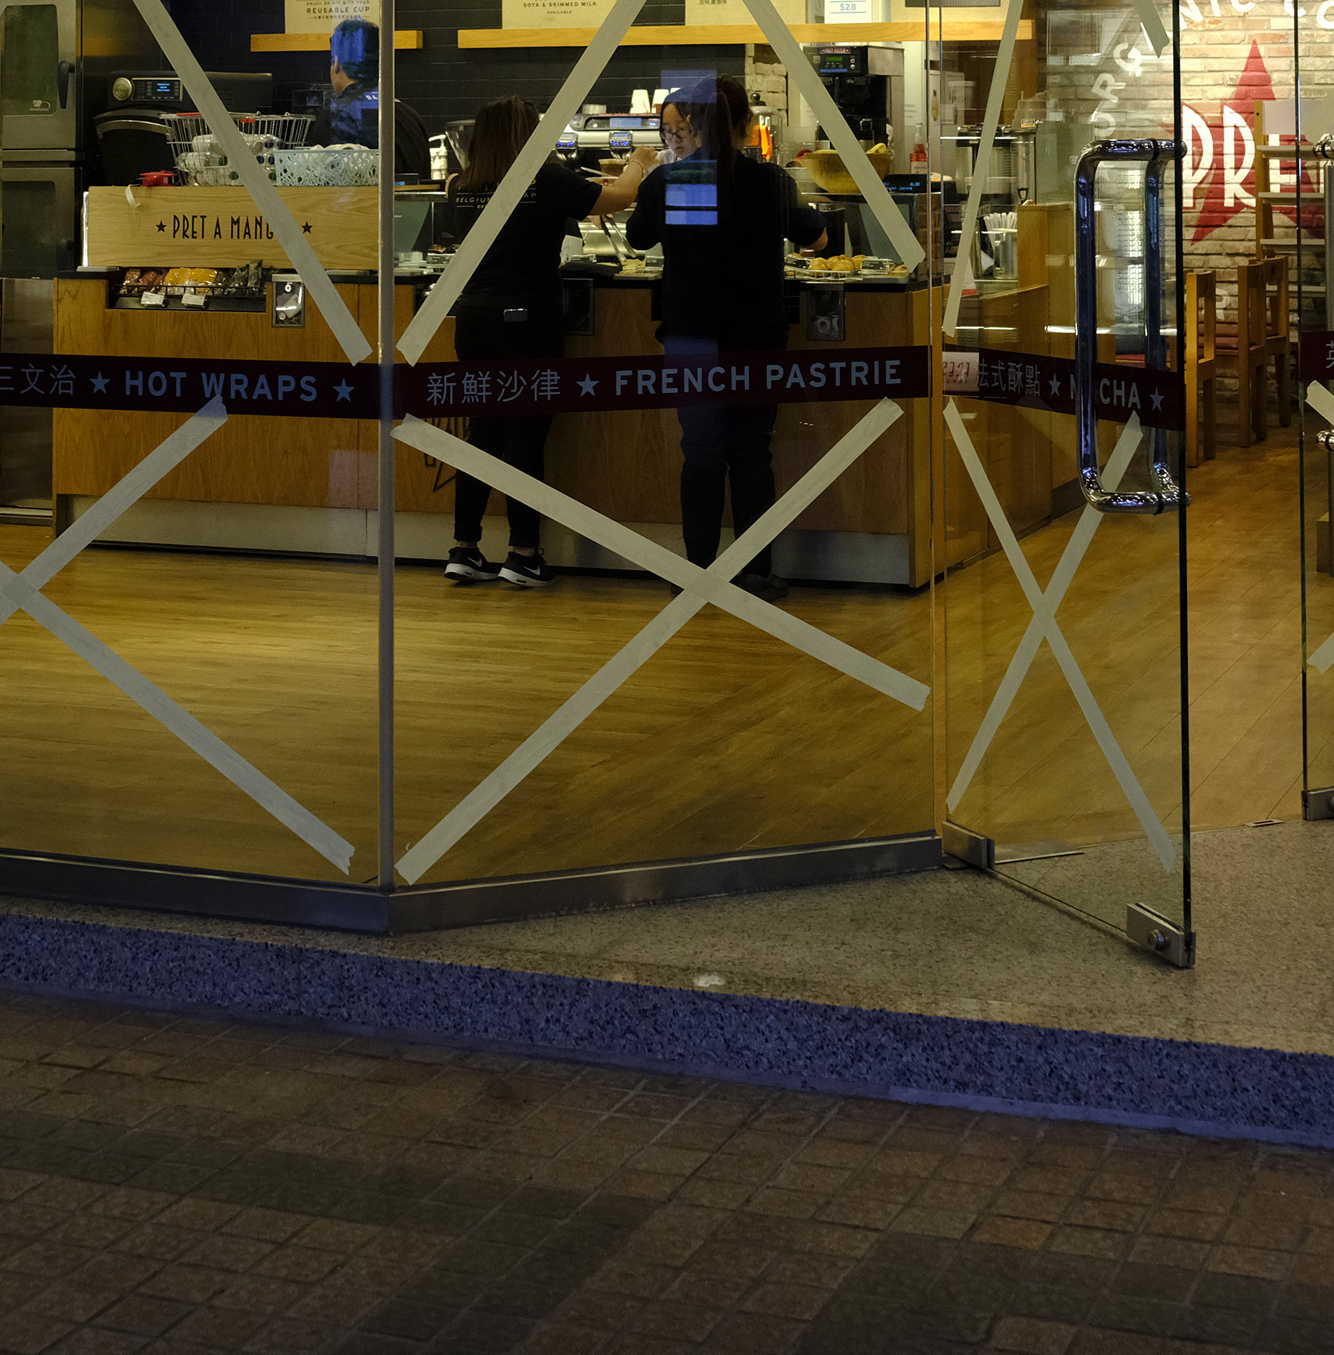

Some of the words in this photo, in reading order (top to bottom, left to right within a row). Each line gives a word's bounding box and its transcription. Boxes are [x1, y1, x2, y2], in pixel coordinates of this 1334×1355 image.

[839, 3, 857, 11] $28
[172, 214, 207, 239] PRET
[213, 215, 222, 240] A
[230, 215, 274, 240] MANG
[124, 370, 187, 399] HOT
[199, 372, 319, 403] WRAPS
[426, 369, 562, 406] 新鮮沙律
[614, 363, 751, 396] FRENCH
[766, 359, 903, 390] PASTRIE
